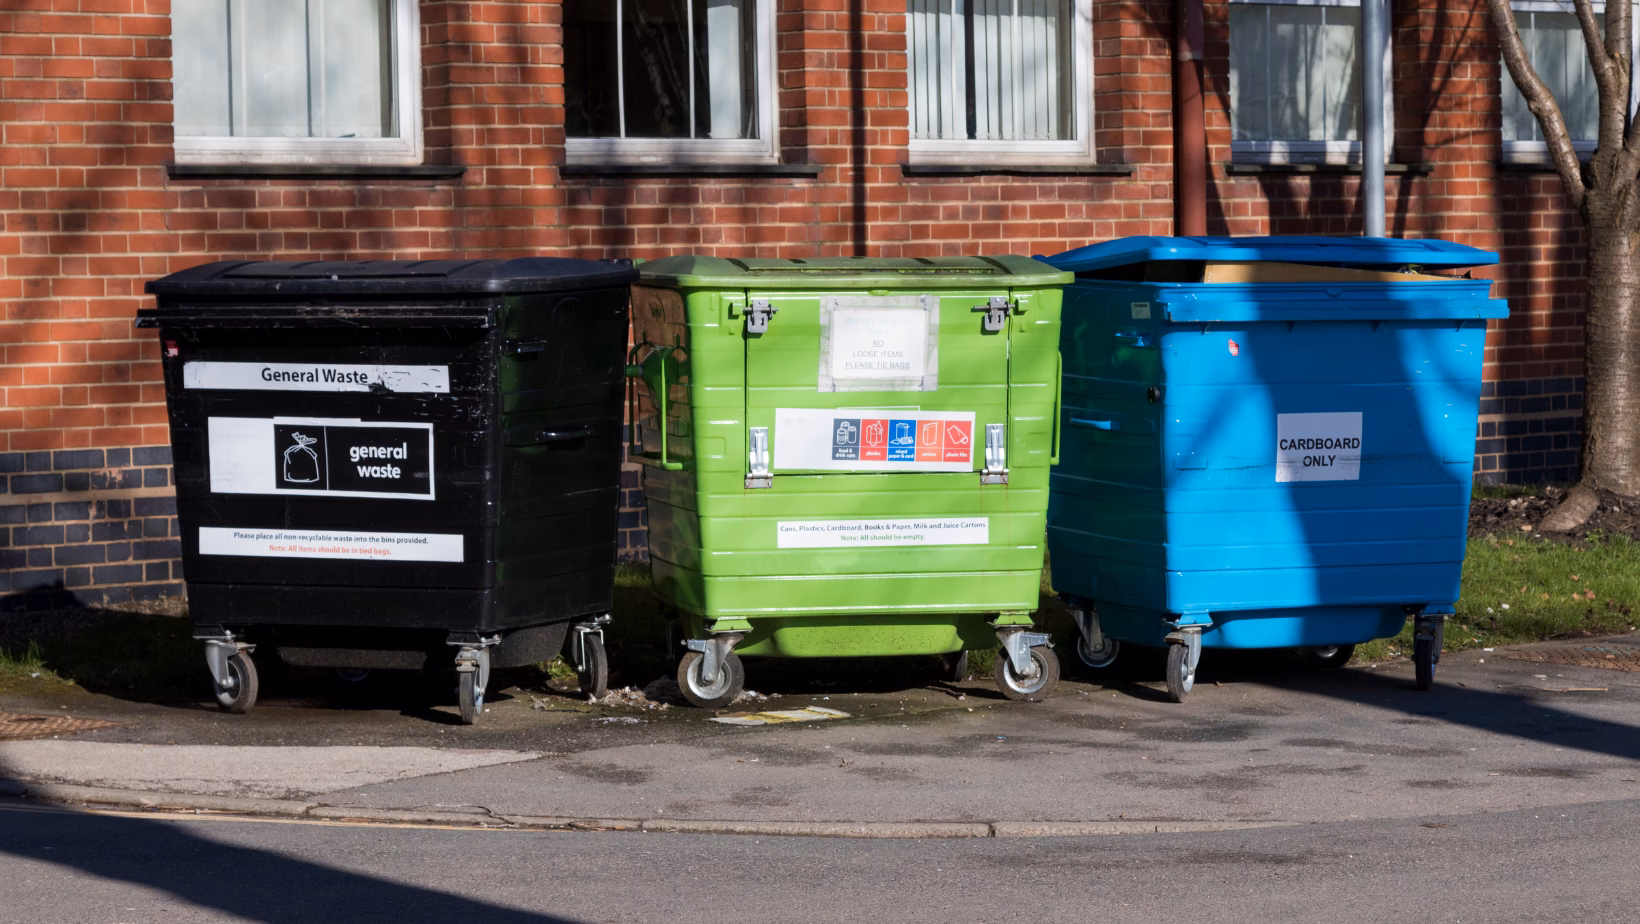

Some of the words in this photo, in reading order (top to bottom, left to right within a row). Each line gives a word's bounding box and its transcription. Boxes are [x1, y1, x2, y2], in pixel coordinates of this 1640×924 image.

[872, 339, 884, 347] NO
[852, 350, 878, 358] LOOSE
[880, 350, 904, 358] ITEMS
[845, 361, 874, 369] PLEASE
[876, 361, 887, 369] TIE
[889, 361, 911, 370] BAGS
[261, 367, 319, 383] General
[322, 368, 368, 384] Waste
[1279, 437, 1360, 451] CARDBOARD
[350, 442, 407, 462] general
[1302, 454, 1337, 467] ONLY
[357, 463, 401, 479] waste
[826, 524, 863, 532] Cardboard,
[864, 523, 885, 531] Books
[891, 523, 912, 531] Paper,
[233, 531, 255, 540] Please
[255, 532, 274, 541] place
[283, 533, 332, 542] non-recyclable
[353, 535, 368, 543] into
[381, 536, 396, 544] bins
[396, 536, 429, 545] provided.
[902, 533, 926, 541] empty.
[268, 544, 287, 552] Note:
[298, 545, 317, 553] items
[317, 545, 341, 553] should
[351, 546, 358, 554] in
[359, 547, 373, 555] tied
[373, 547, 392, 556] bags.
